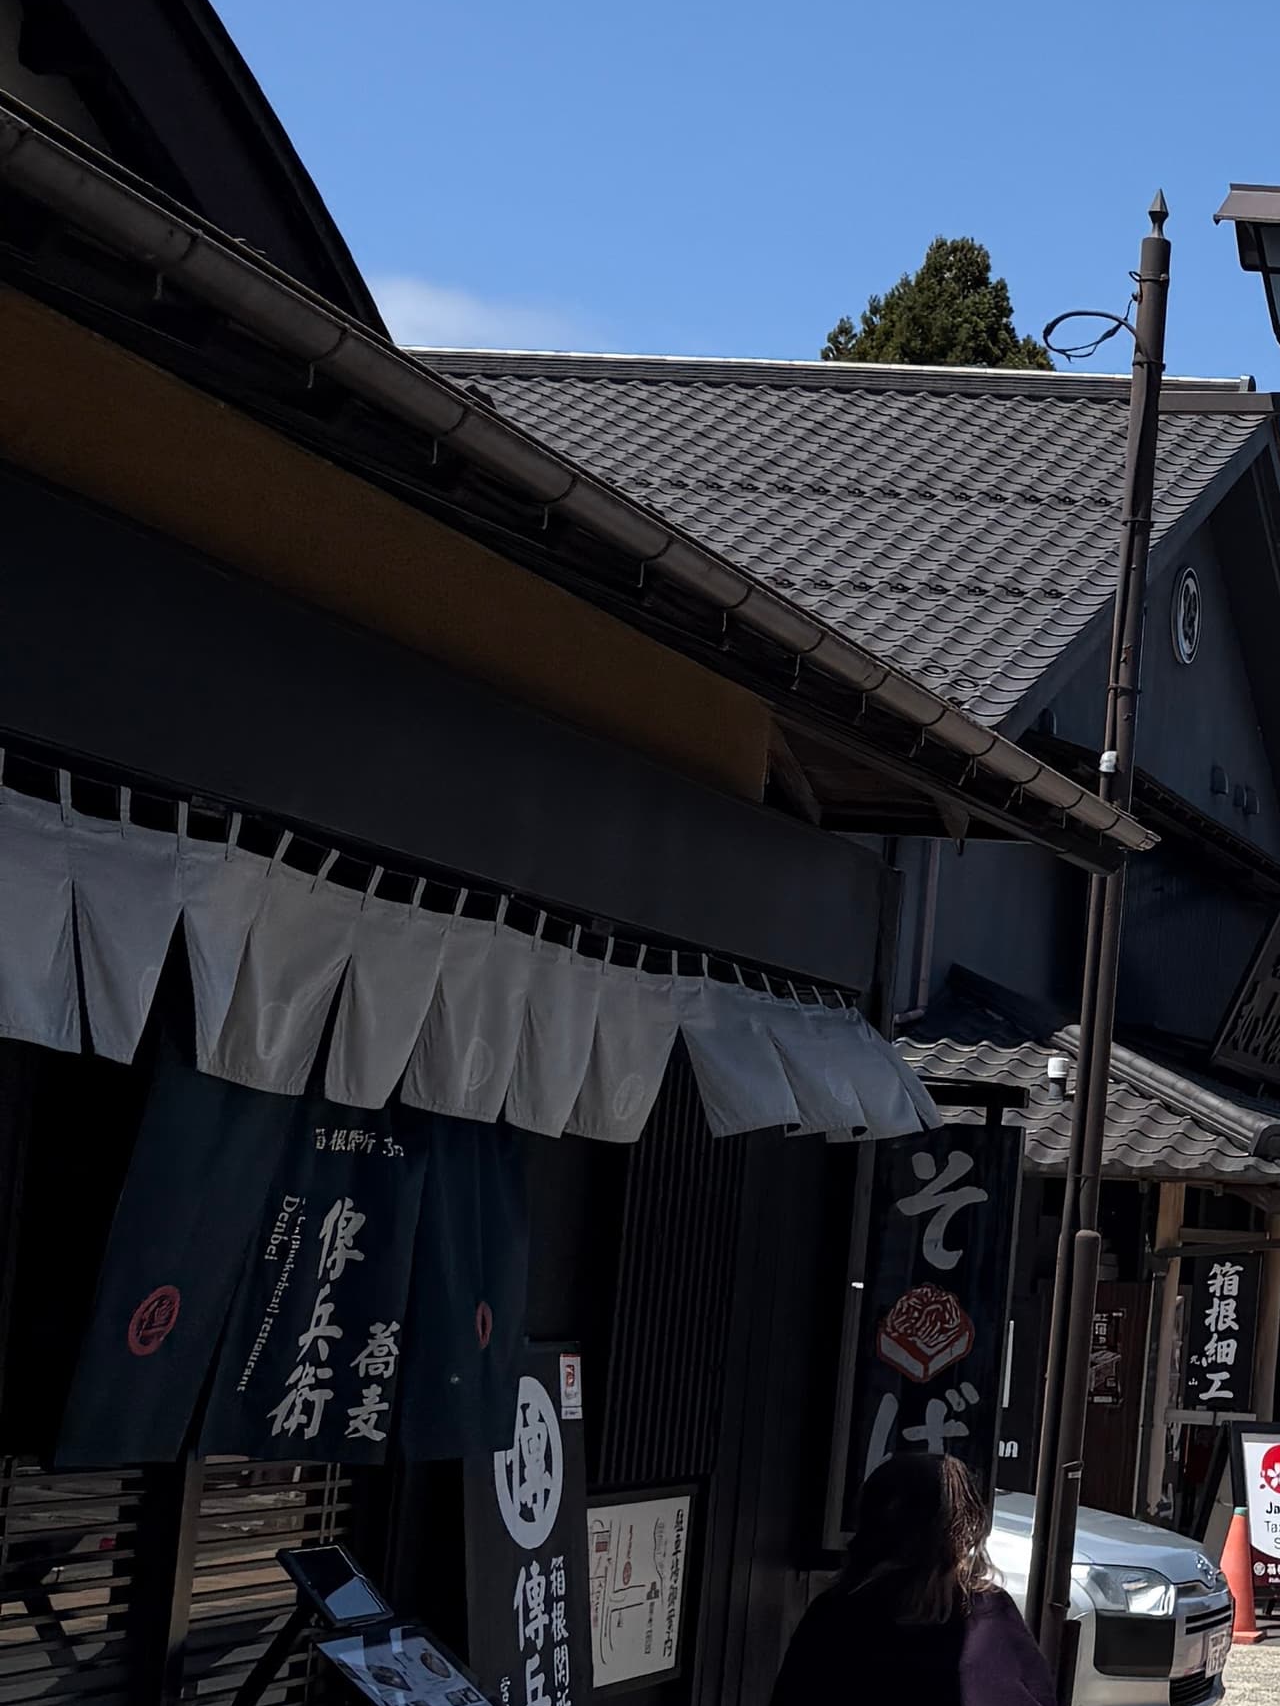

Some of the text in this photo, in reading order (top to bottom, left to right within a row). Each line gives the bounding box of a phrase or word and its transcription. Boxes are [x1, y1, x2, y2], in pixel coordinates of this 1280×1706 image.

[346, 1320, 401, 1442] 蕎麦
[1199, 1261, 1245, 1401] 箱根細工
